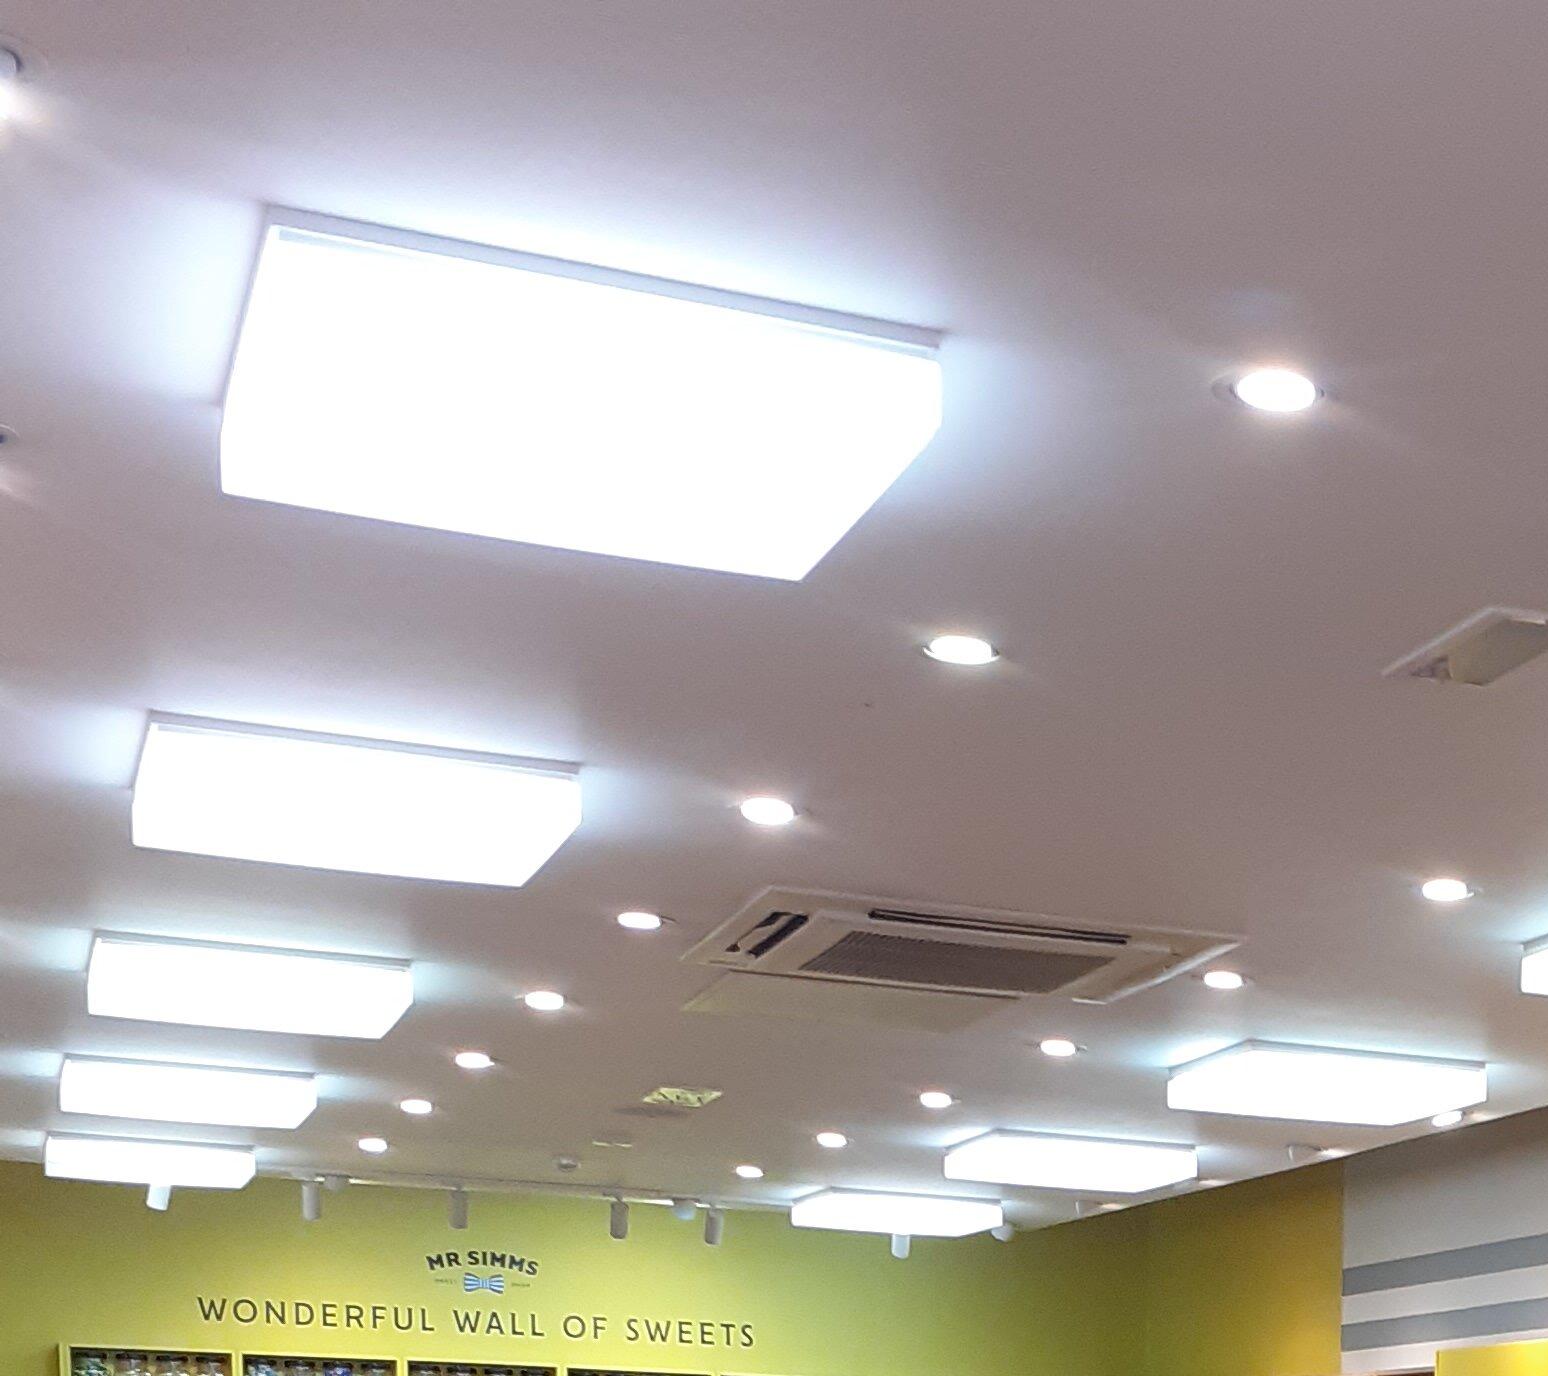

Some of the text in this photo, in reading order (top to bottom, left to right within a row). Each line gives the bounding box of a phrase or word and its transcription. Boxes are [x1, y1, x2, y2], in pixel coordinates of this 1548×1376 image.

[426, 1251, 539, 1275] MR SIMMS
[197, 1297, 755, 1347] WONDERFUL WALL OF SWEETS
